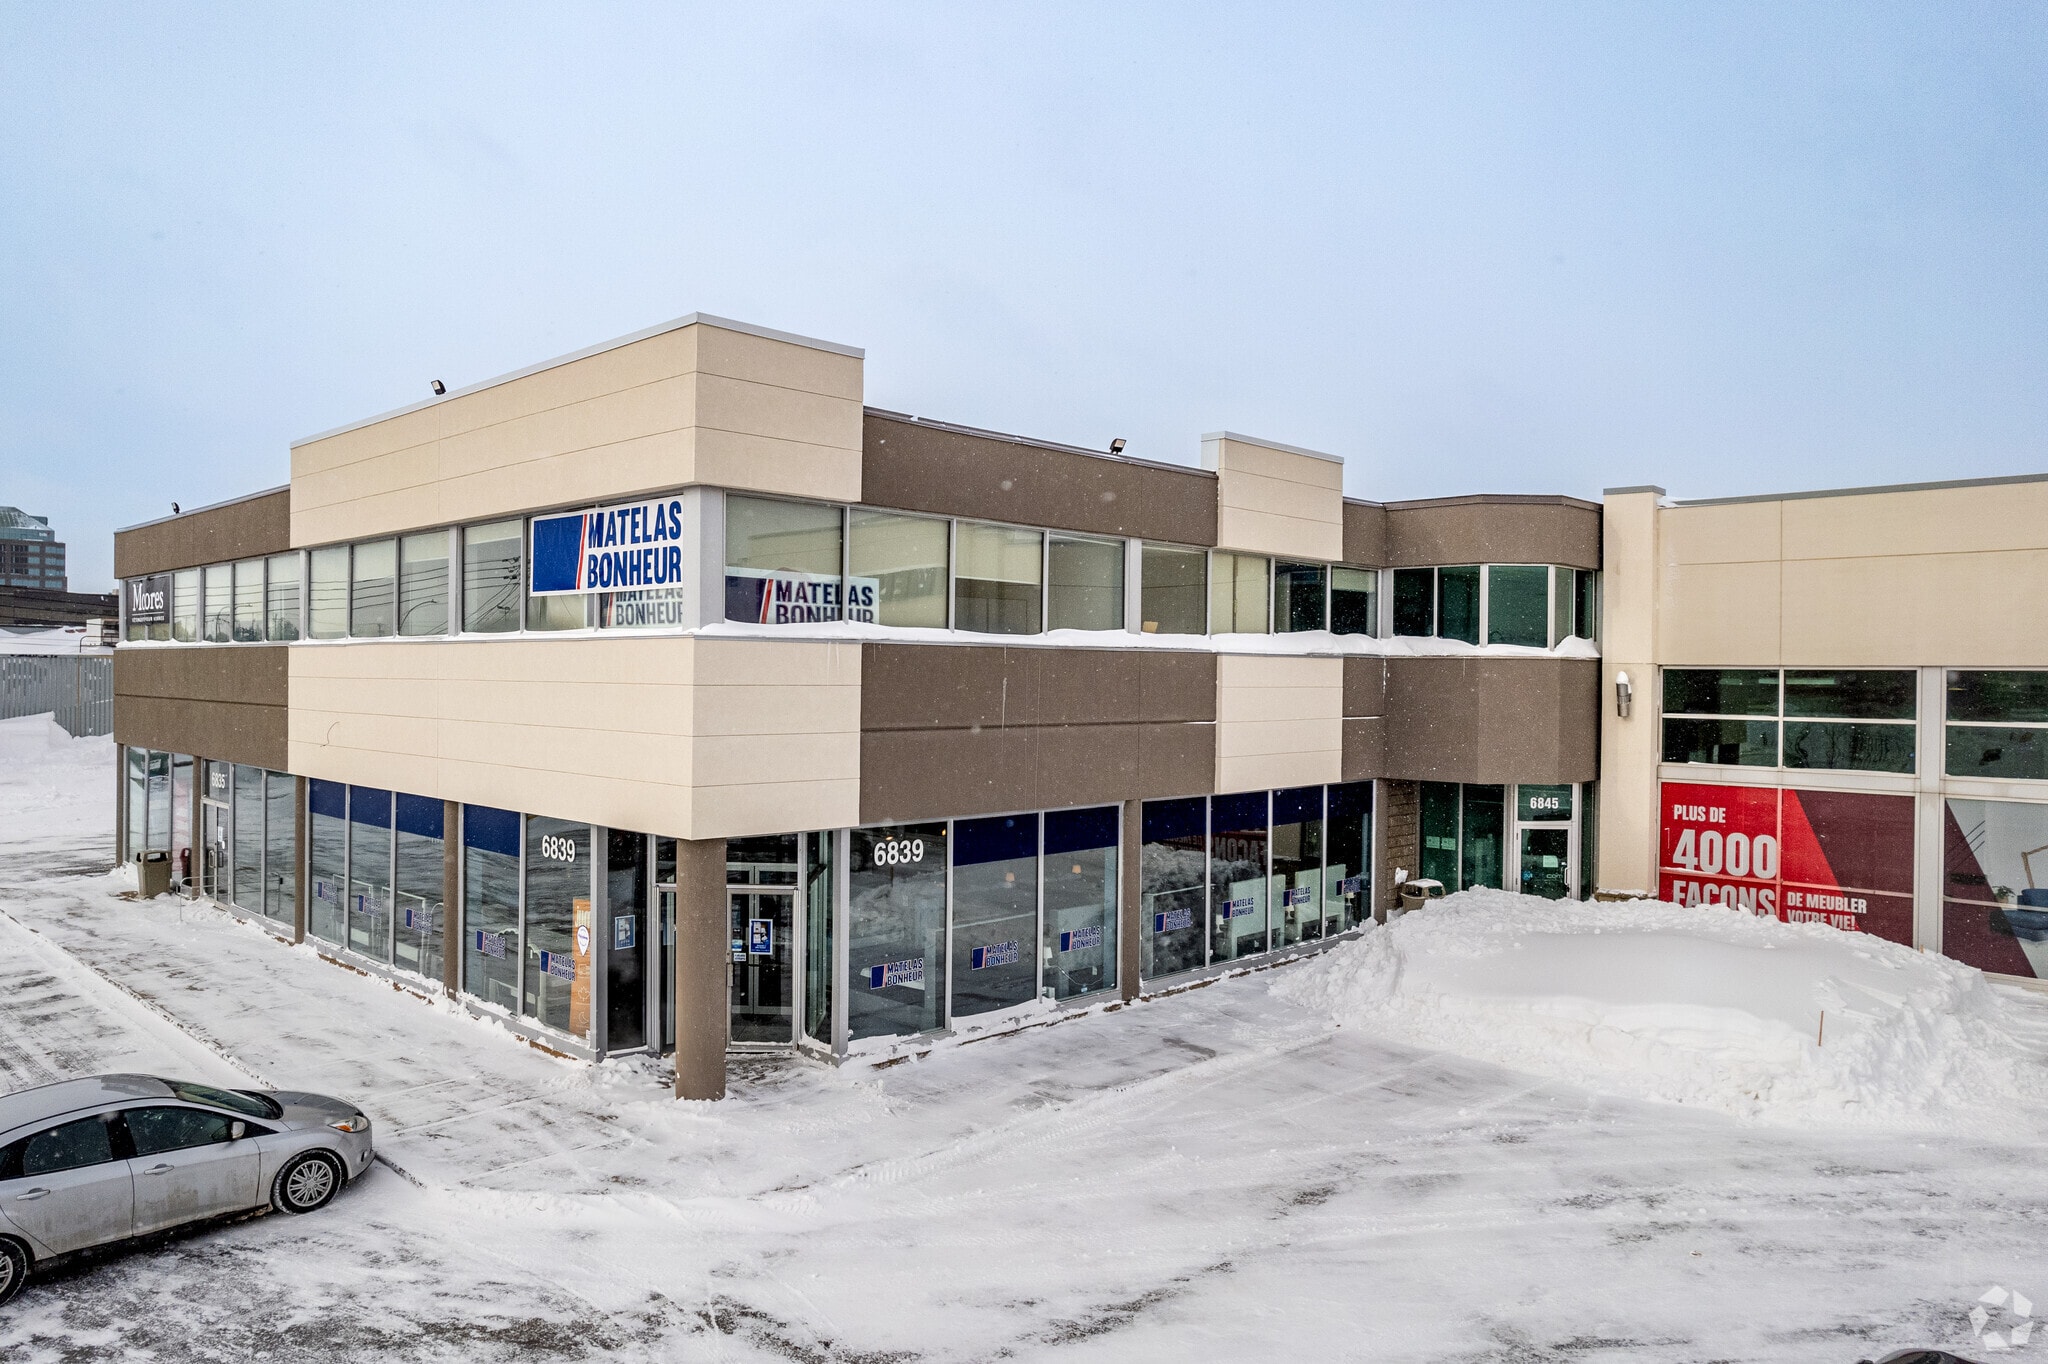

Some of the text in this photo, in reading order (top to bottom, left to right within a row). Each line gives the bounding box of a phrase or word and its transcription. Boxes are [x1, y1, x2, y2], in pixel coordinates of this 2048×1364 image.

[588, 500, 682, 549] MATELAS
[587, 545, 682, 588] BONHEUR
[132, 583, 164, 611] Moores
[1530, 797, 1559, 809] 6845
[1673, 804, 1726, 823] PLUS DE
[542, 835, 575, 863] 6839
[873, 838, 924, 866] 6839
[1672, 829, 1777, 879] 4000
[1232, 897, 1254, 907] MATELAS
[1787, 891, 1867, 914] DE MEUBLER
[1787, 909, 1856, 930] VOTRE VIE!
[1072, 926, 1100, 939] MATELAS
[986, 940, 1018, 955] MATELAS
[1072, 936, 1100, 949] BONHEUR
[550, 952, 576, 970] MATELAS
[887, 958, 923, 974] MATELAS
[986, 951, 1018, 967] BONHEUR
[550, 965, 576, 981] BONHEUR
[887, 970, 923, 986] BONHEUR
